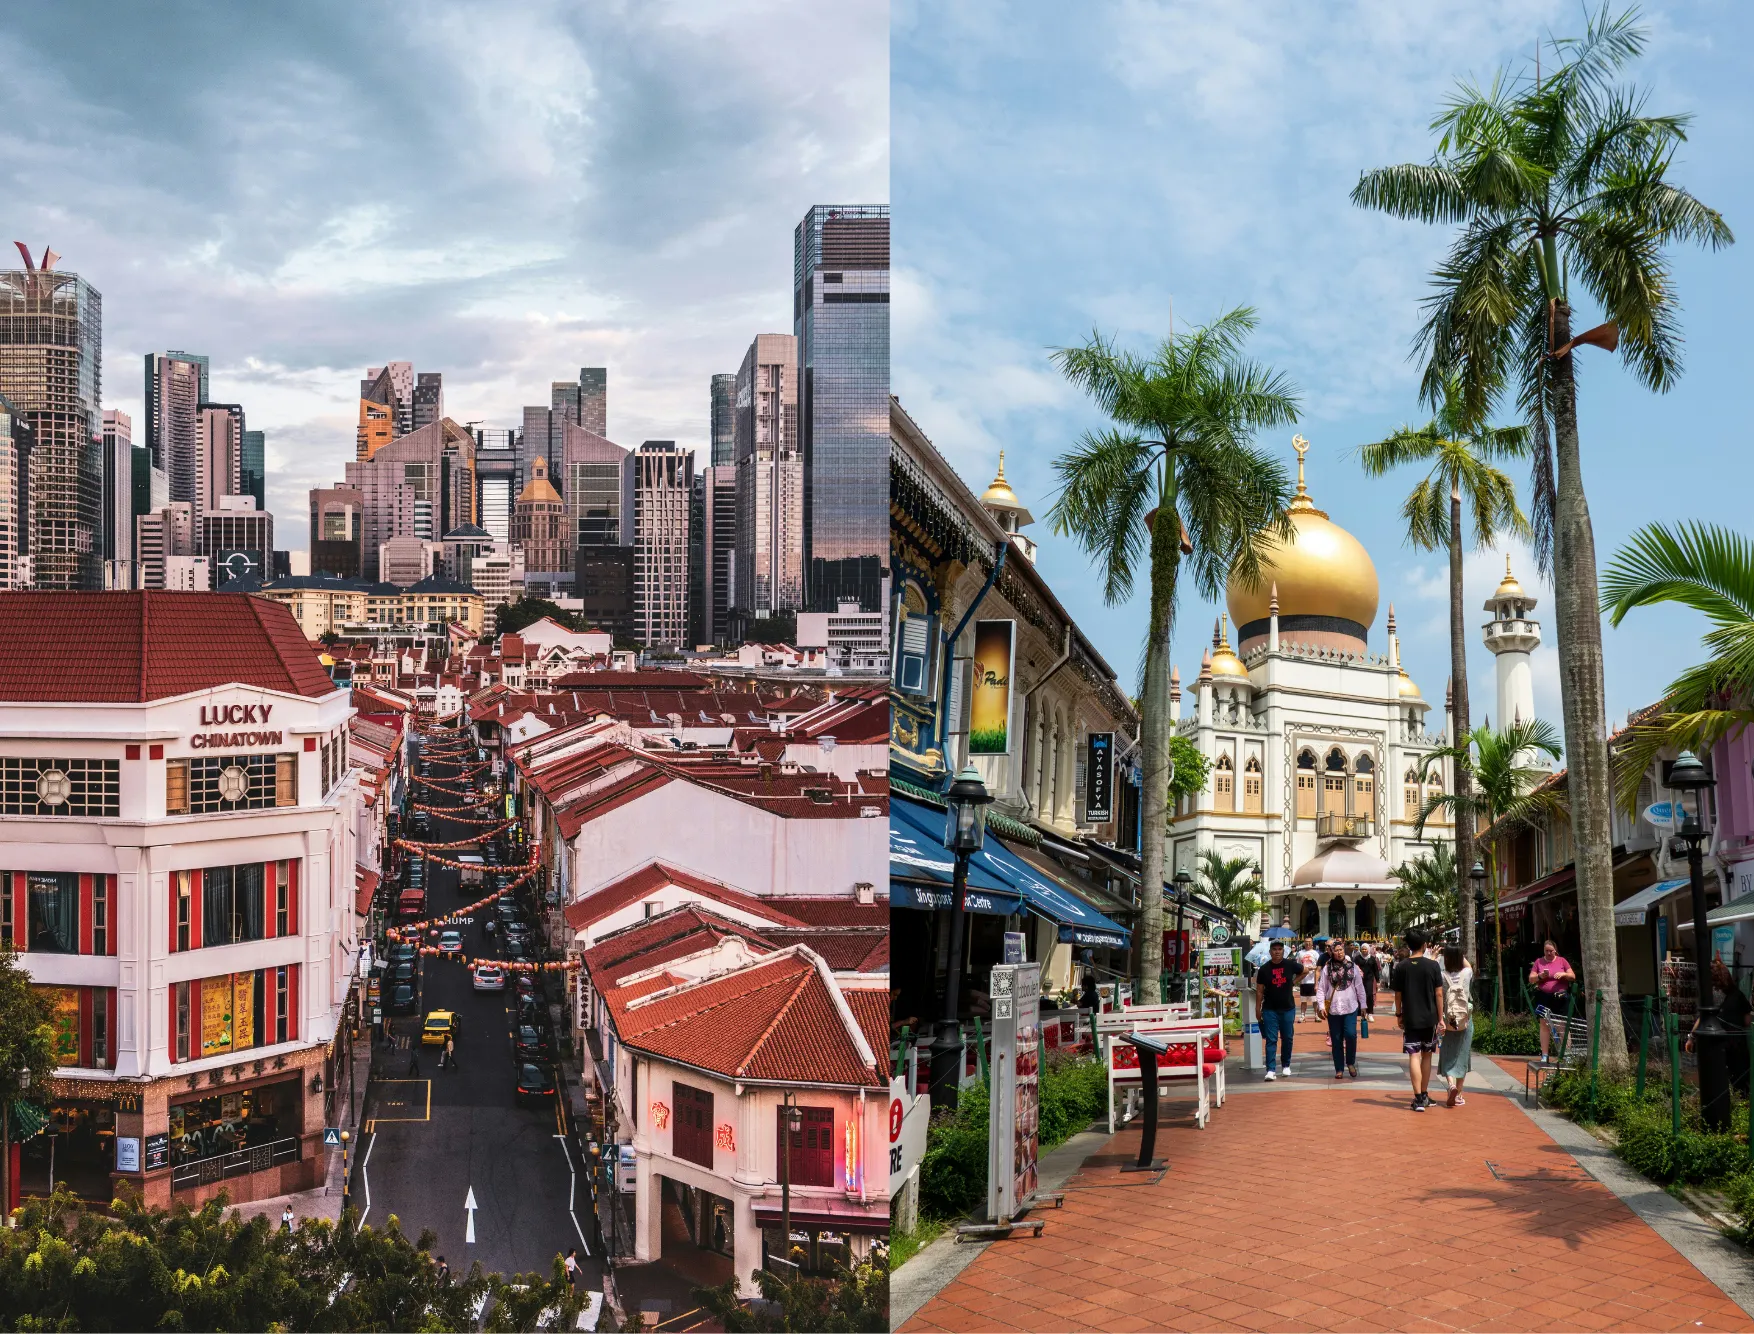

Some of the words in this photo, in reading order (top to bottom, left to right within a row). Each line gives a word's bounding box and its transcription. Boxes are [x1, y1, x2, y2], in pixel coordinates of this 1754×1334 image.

[200, 704, 273, 726] LUCKY
[190, 730, 283, 749] CHINATOWN
[1095, 749, 1104, 809] AYASOFYA
[1740, 873, 1752, 892] BY
[915, 887, 953, 909] Singapore
[444, 917, 474, 925] HUMP
[890, 1145, 903, 1176] RE
